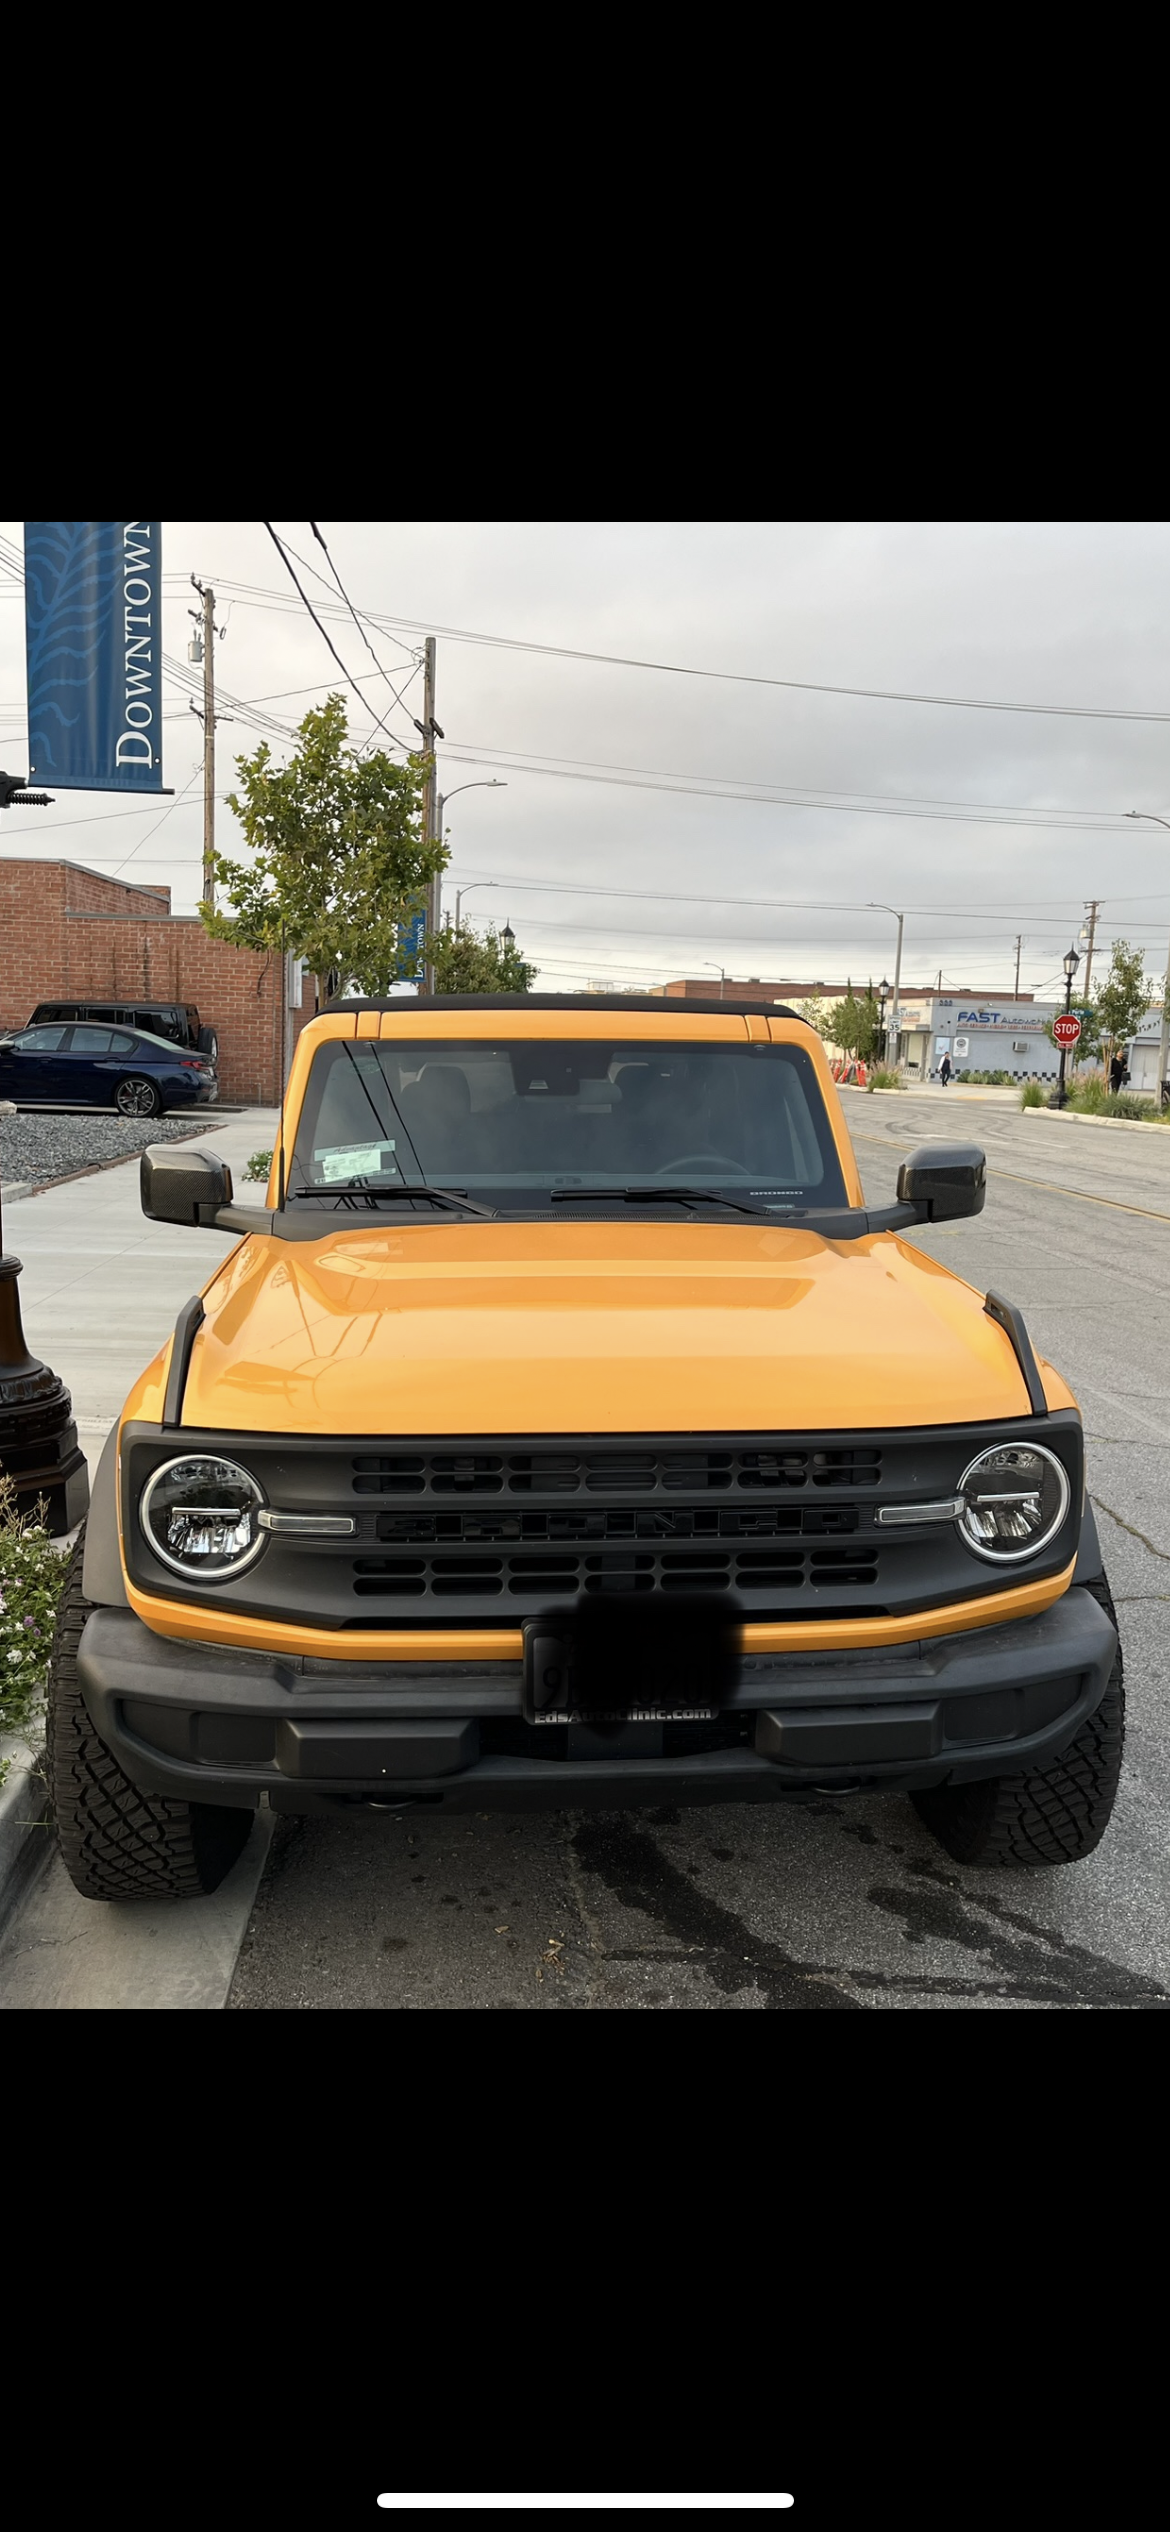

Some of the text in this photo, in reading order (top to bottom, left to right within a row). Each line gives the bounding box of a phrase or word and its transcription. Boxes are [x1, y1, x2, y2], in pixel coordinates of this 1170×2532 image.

[115, 522, 152, 769] DOWNTOWN
[957, 1011, 1001, 1023] FAST
[1054, 1023, 1079, 1035] STOP
